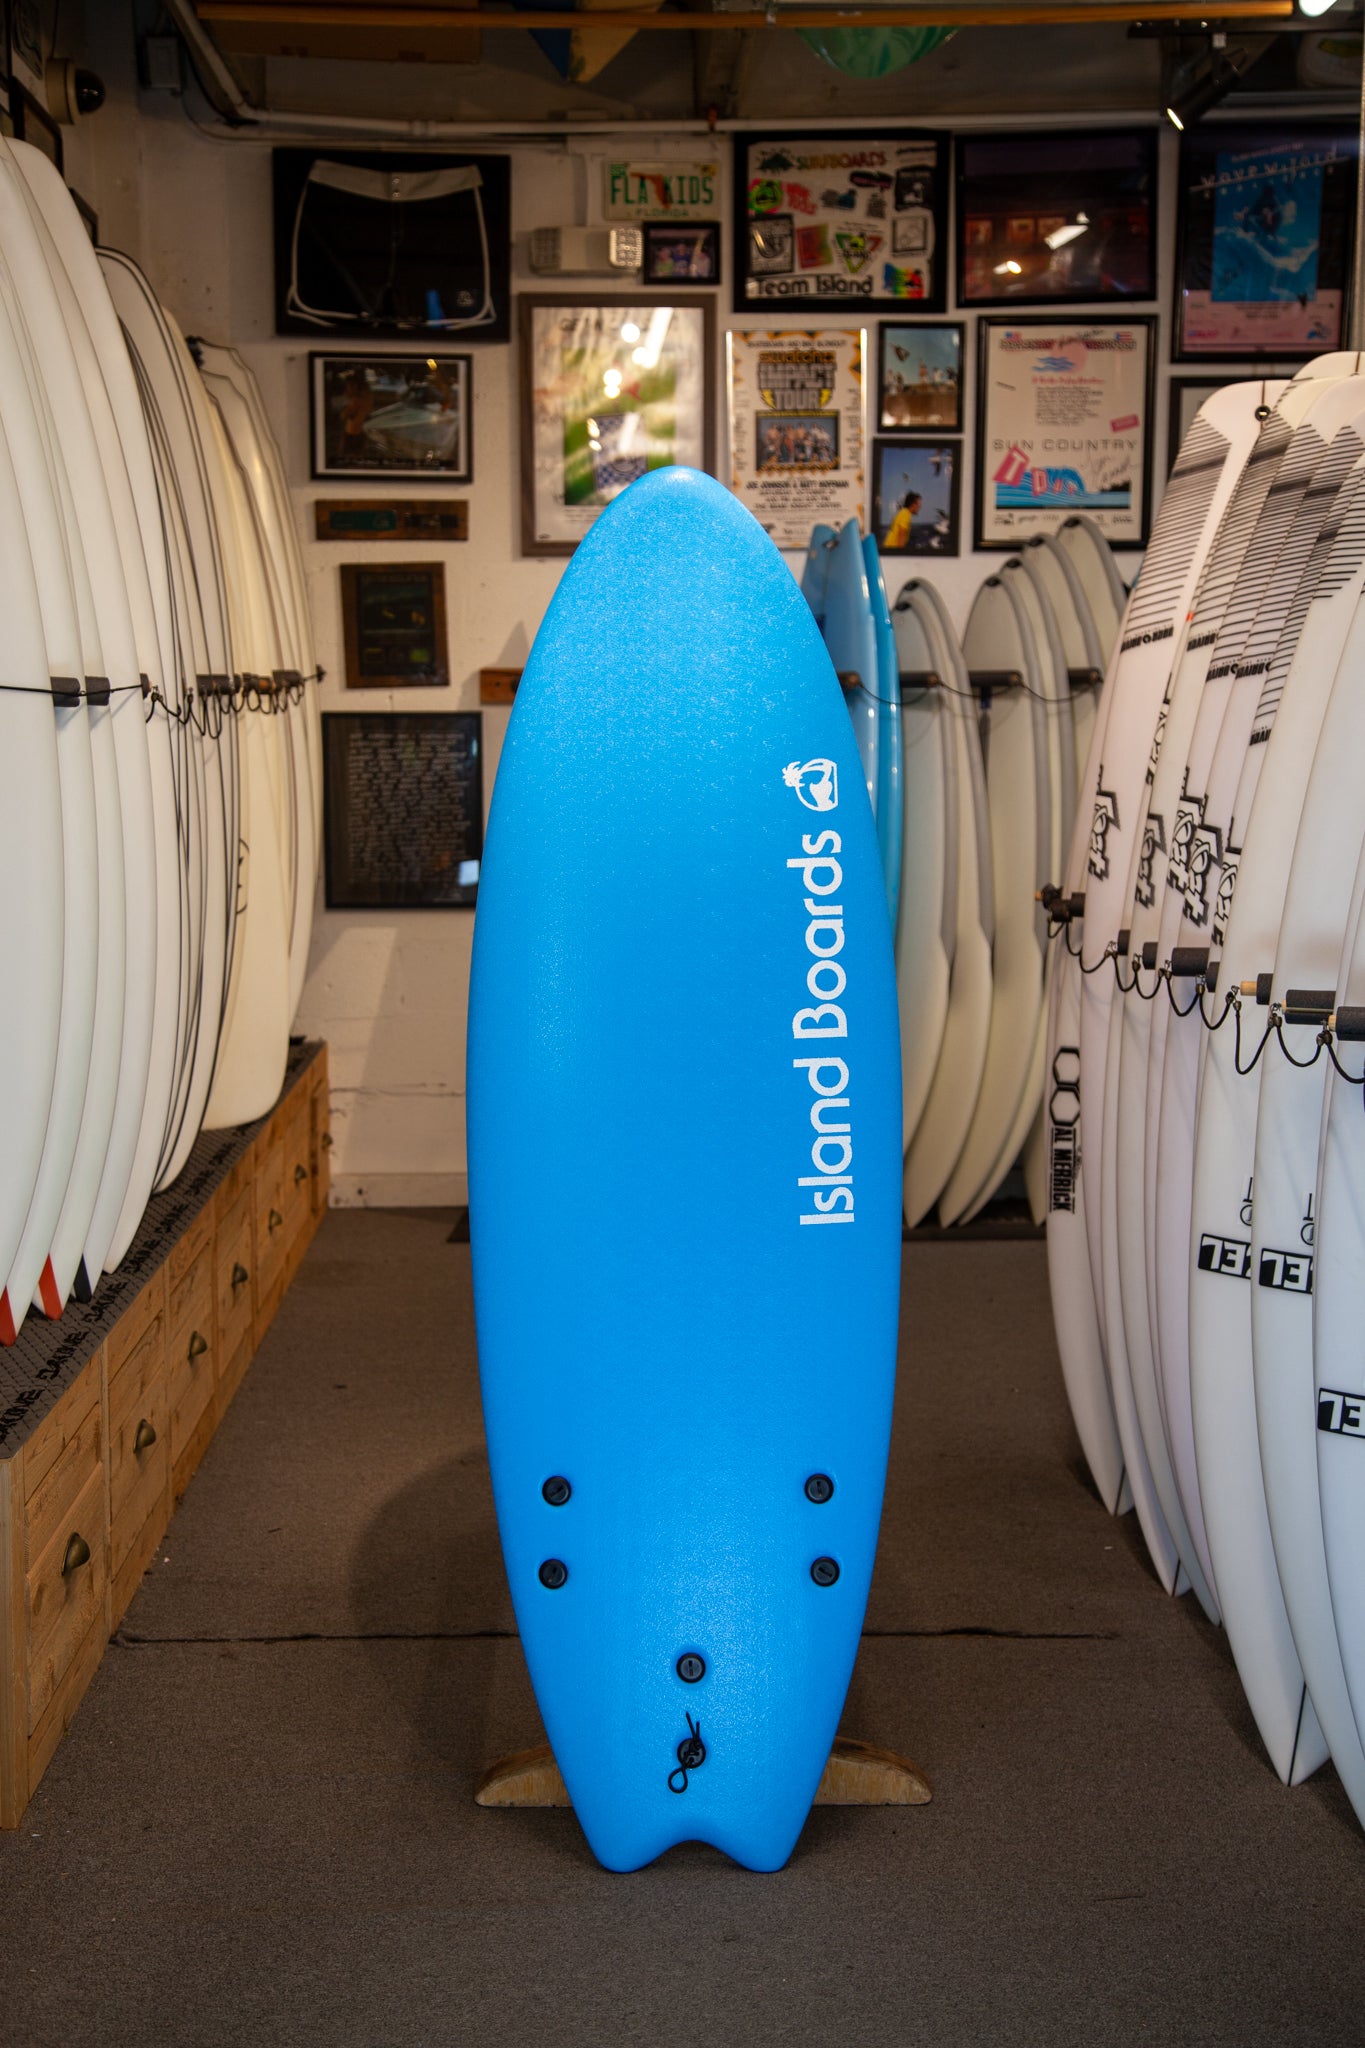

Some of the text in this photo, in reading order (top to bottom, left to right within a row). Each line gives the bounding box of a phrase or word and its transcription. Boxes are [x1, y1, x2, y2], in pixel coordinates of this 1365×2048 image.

[815, 274, 873, 295] Island
[775, 388, 820, 410] TOUR
[993, 438, 1137, 451] SUN COUNTRY
[786, 829, 855, 1226] Island Boards
[1052, 1127, 1074, 1212] AL MERRICK
